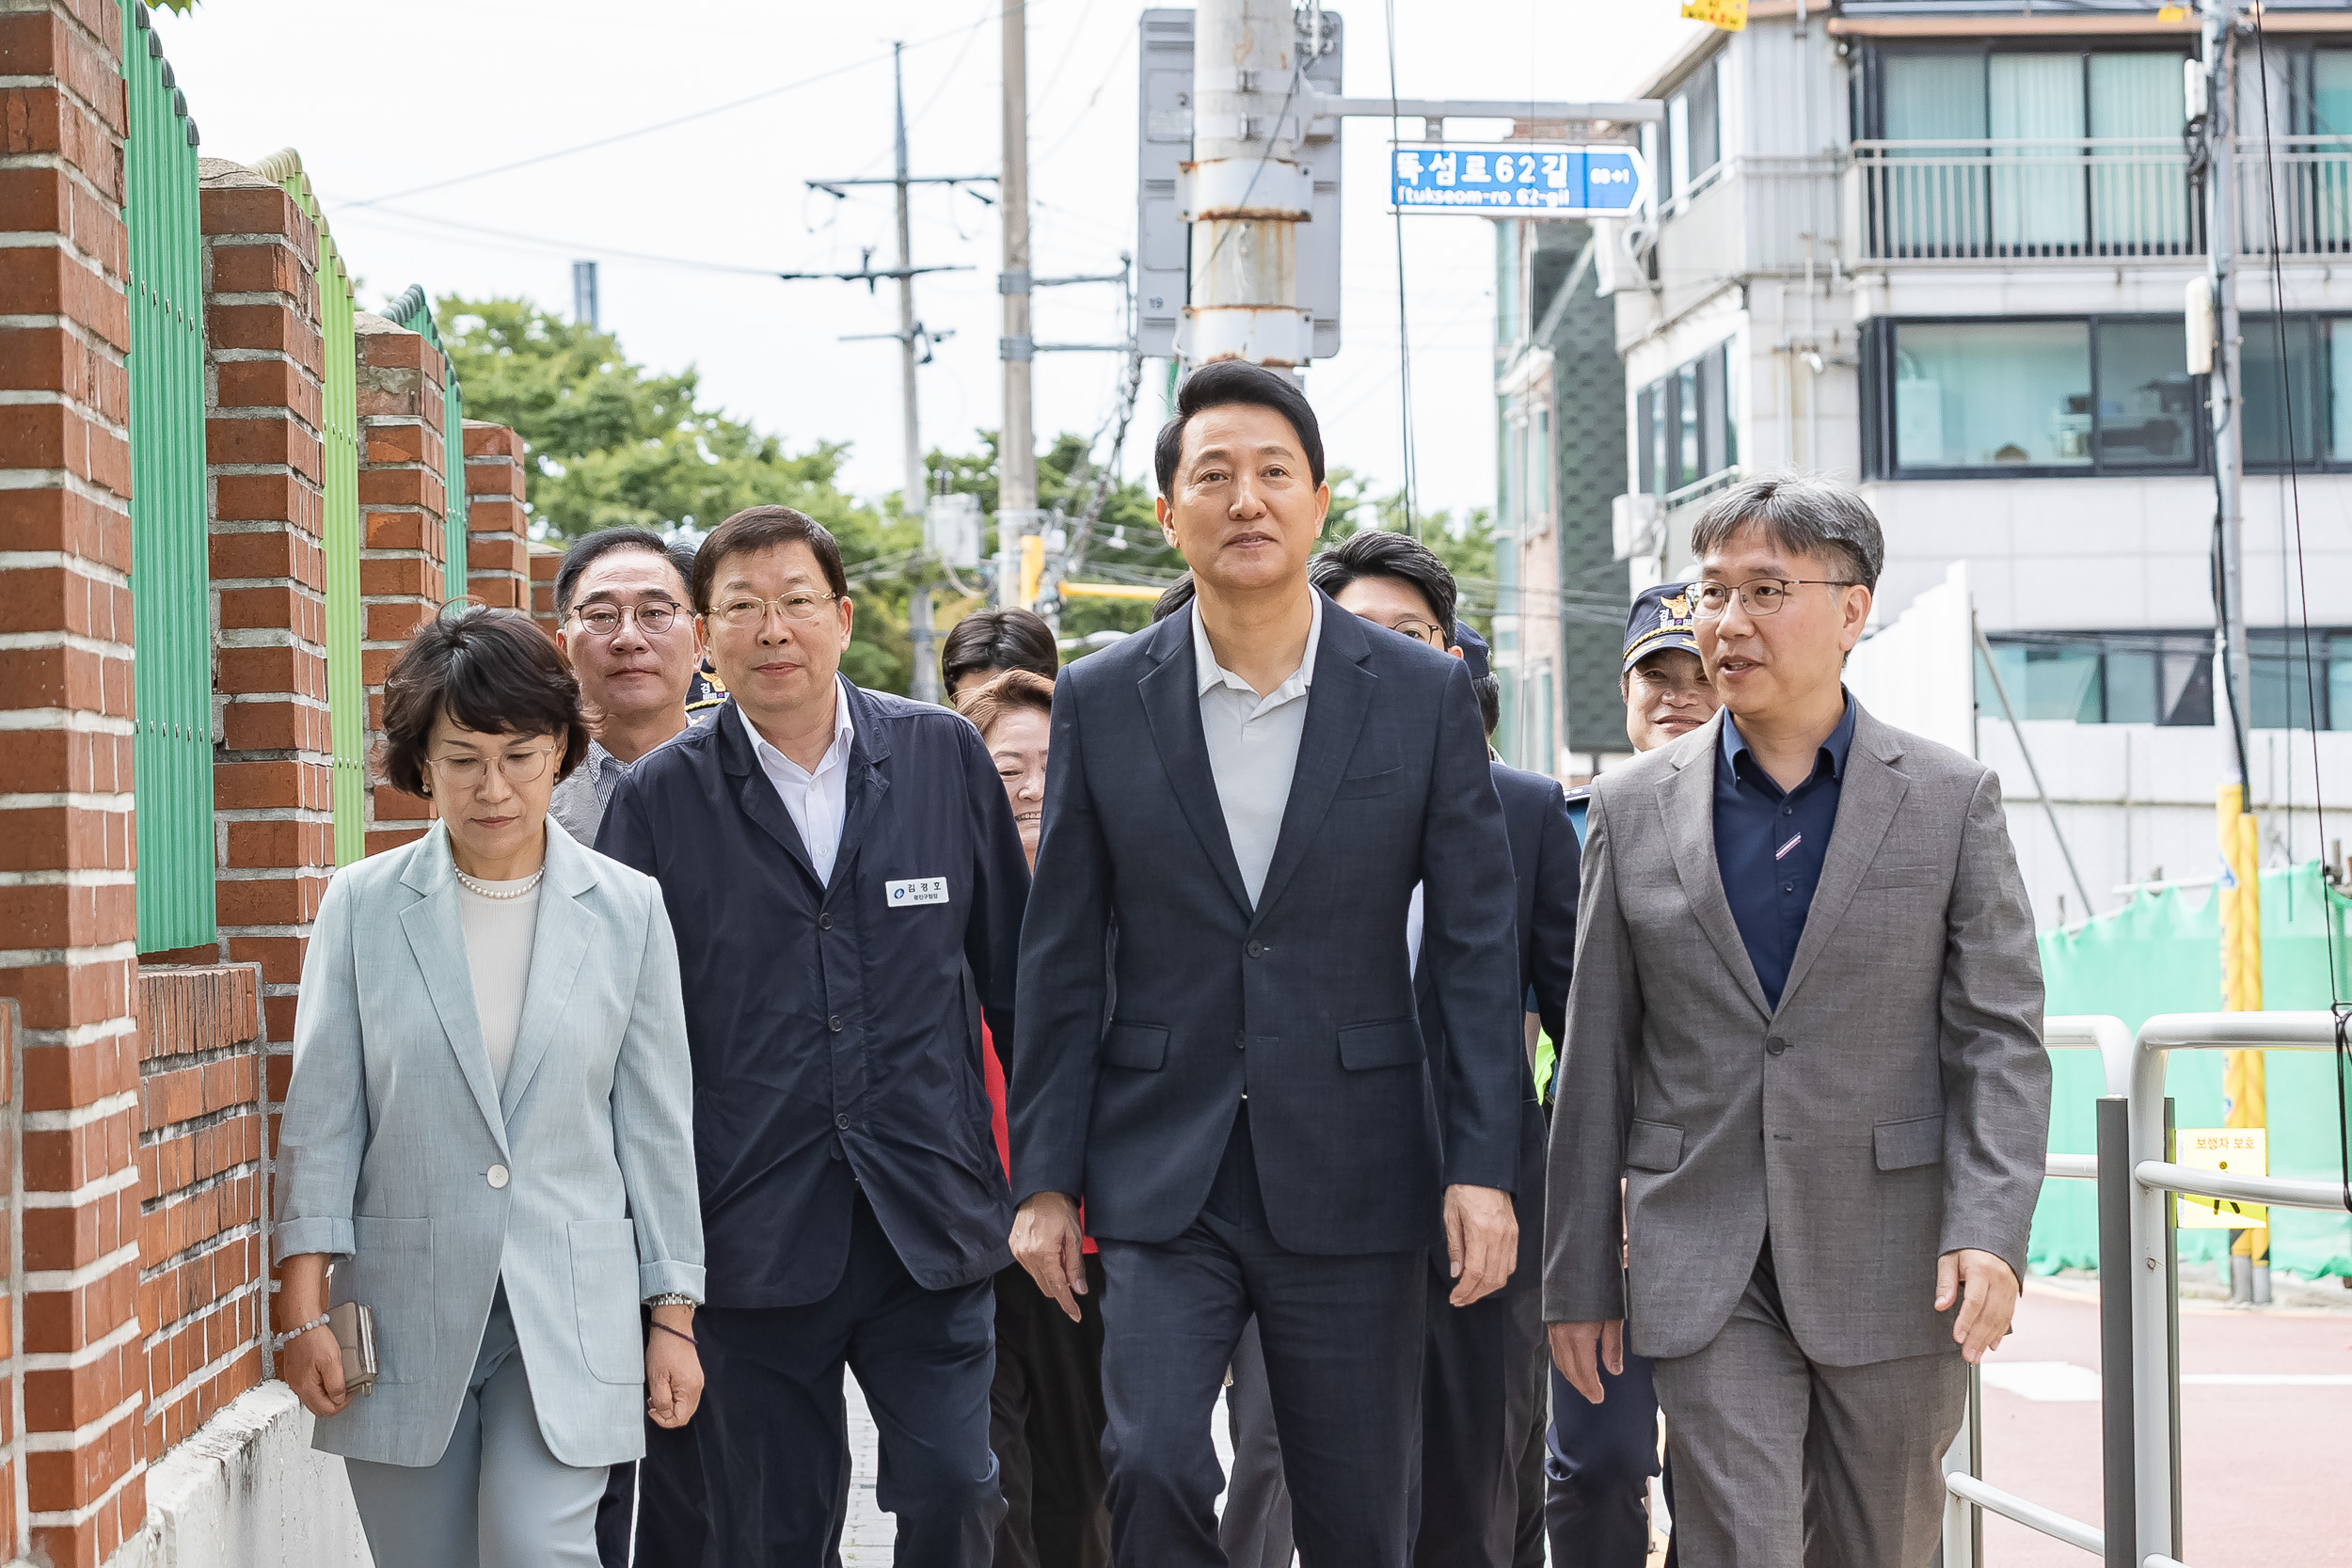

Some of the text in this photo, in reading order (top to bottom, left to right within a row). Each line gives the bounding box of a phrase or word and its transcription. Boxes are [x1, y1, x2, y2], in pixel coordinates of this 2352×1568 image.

[1396, 151, 1567, 188] 뚝섬로62길
[1516, 187, 1570, 207] 62-gil
[2196, 1136, 2255, 1150] 보행자 보호
